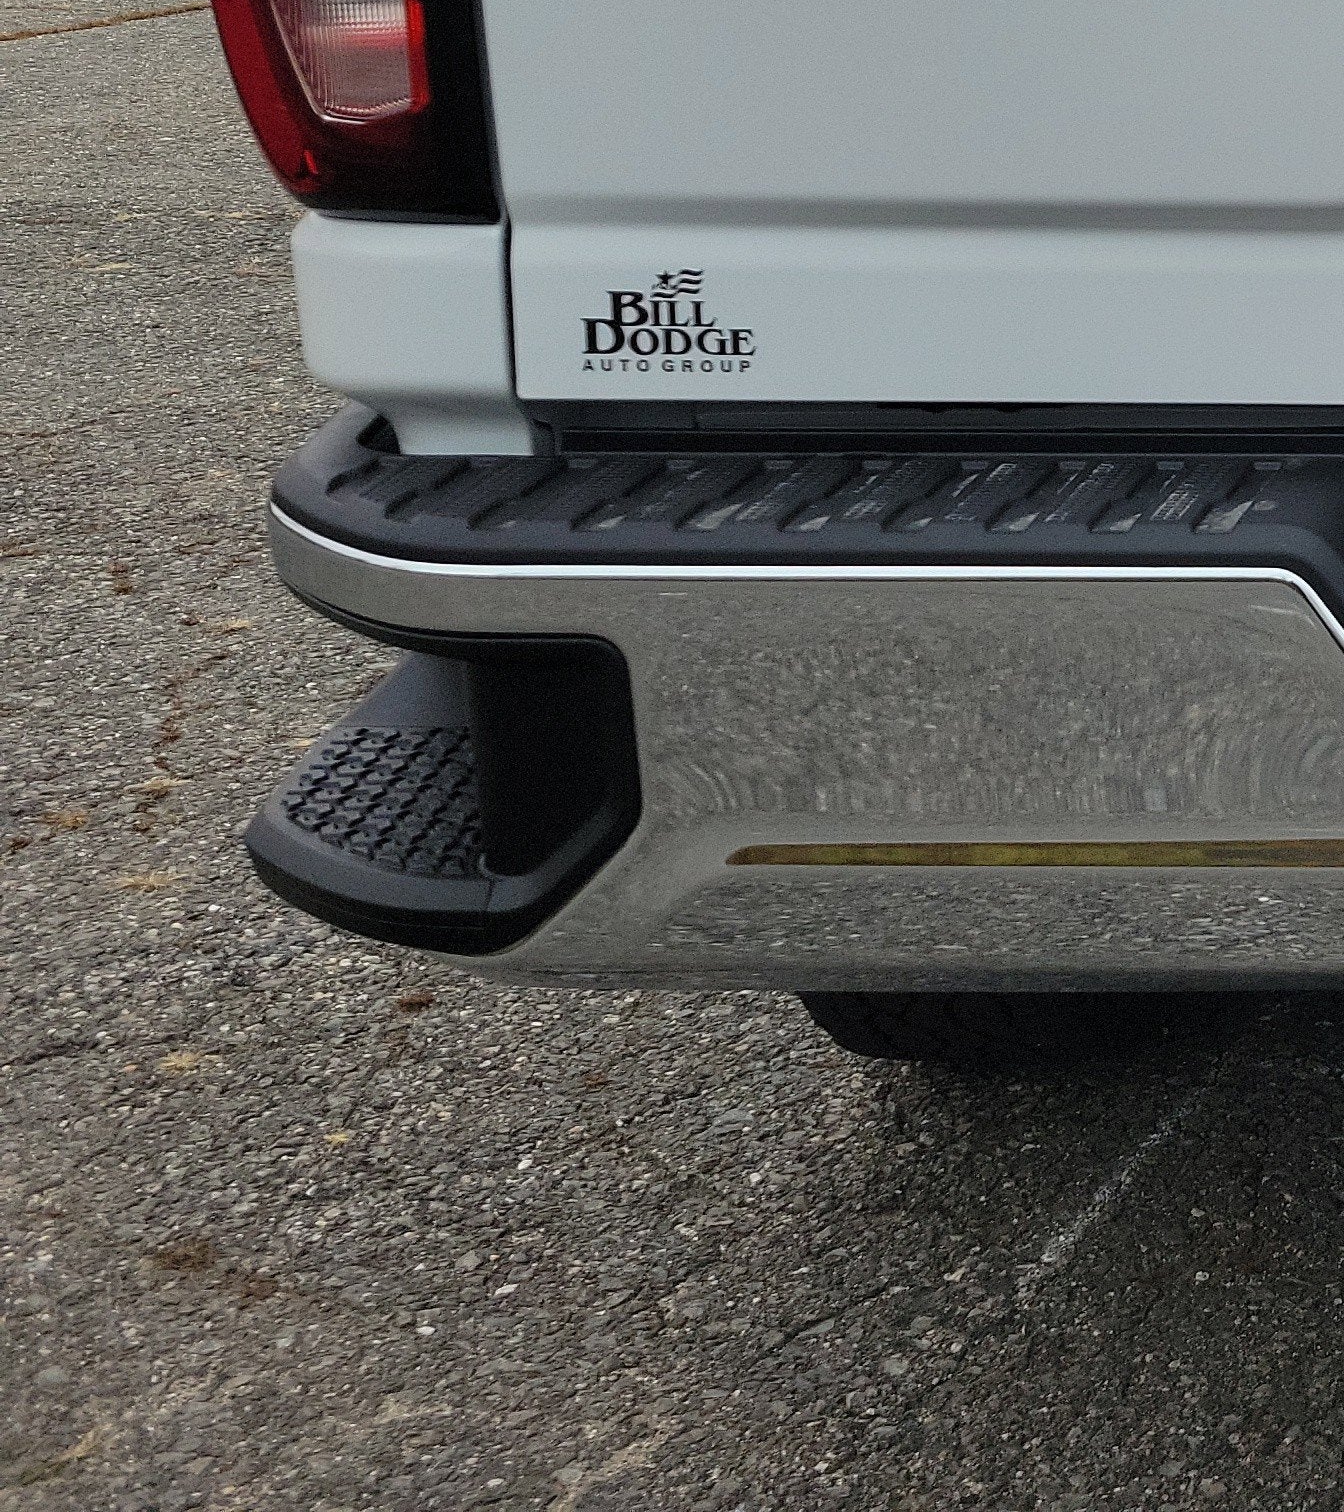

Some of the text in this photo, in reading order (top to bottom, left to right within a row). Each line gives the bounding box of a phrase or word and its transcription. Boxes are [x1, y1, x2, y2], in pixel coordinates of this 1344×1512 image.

[607, 290, 716, 326] BILL
[580, 318, 756, 356] DODGE
[582, 359, 752, 372] AUTO GROUP
